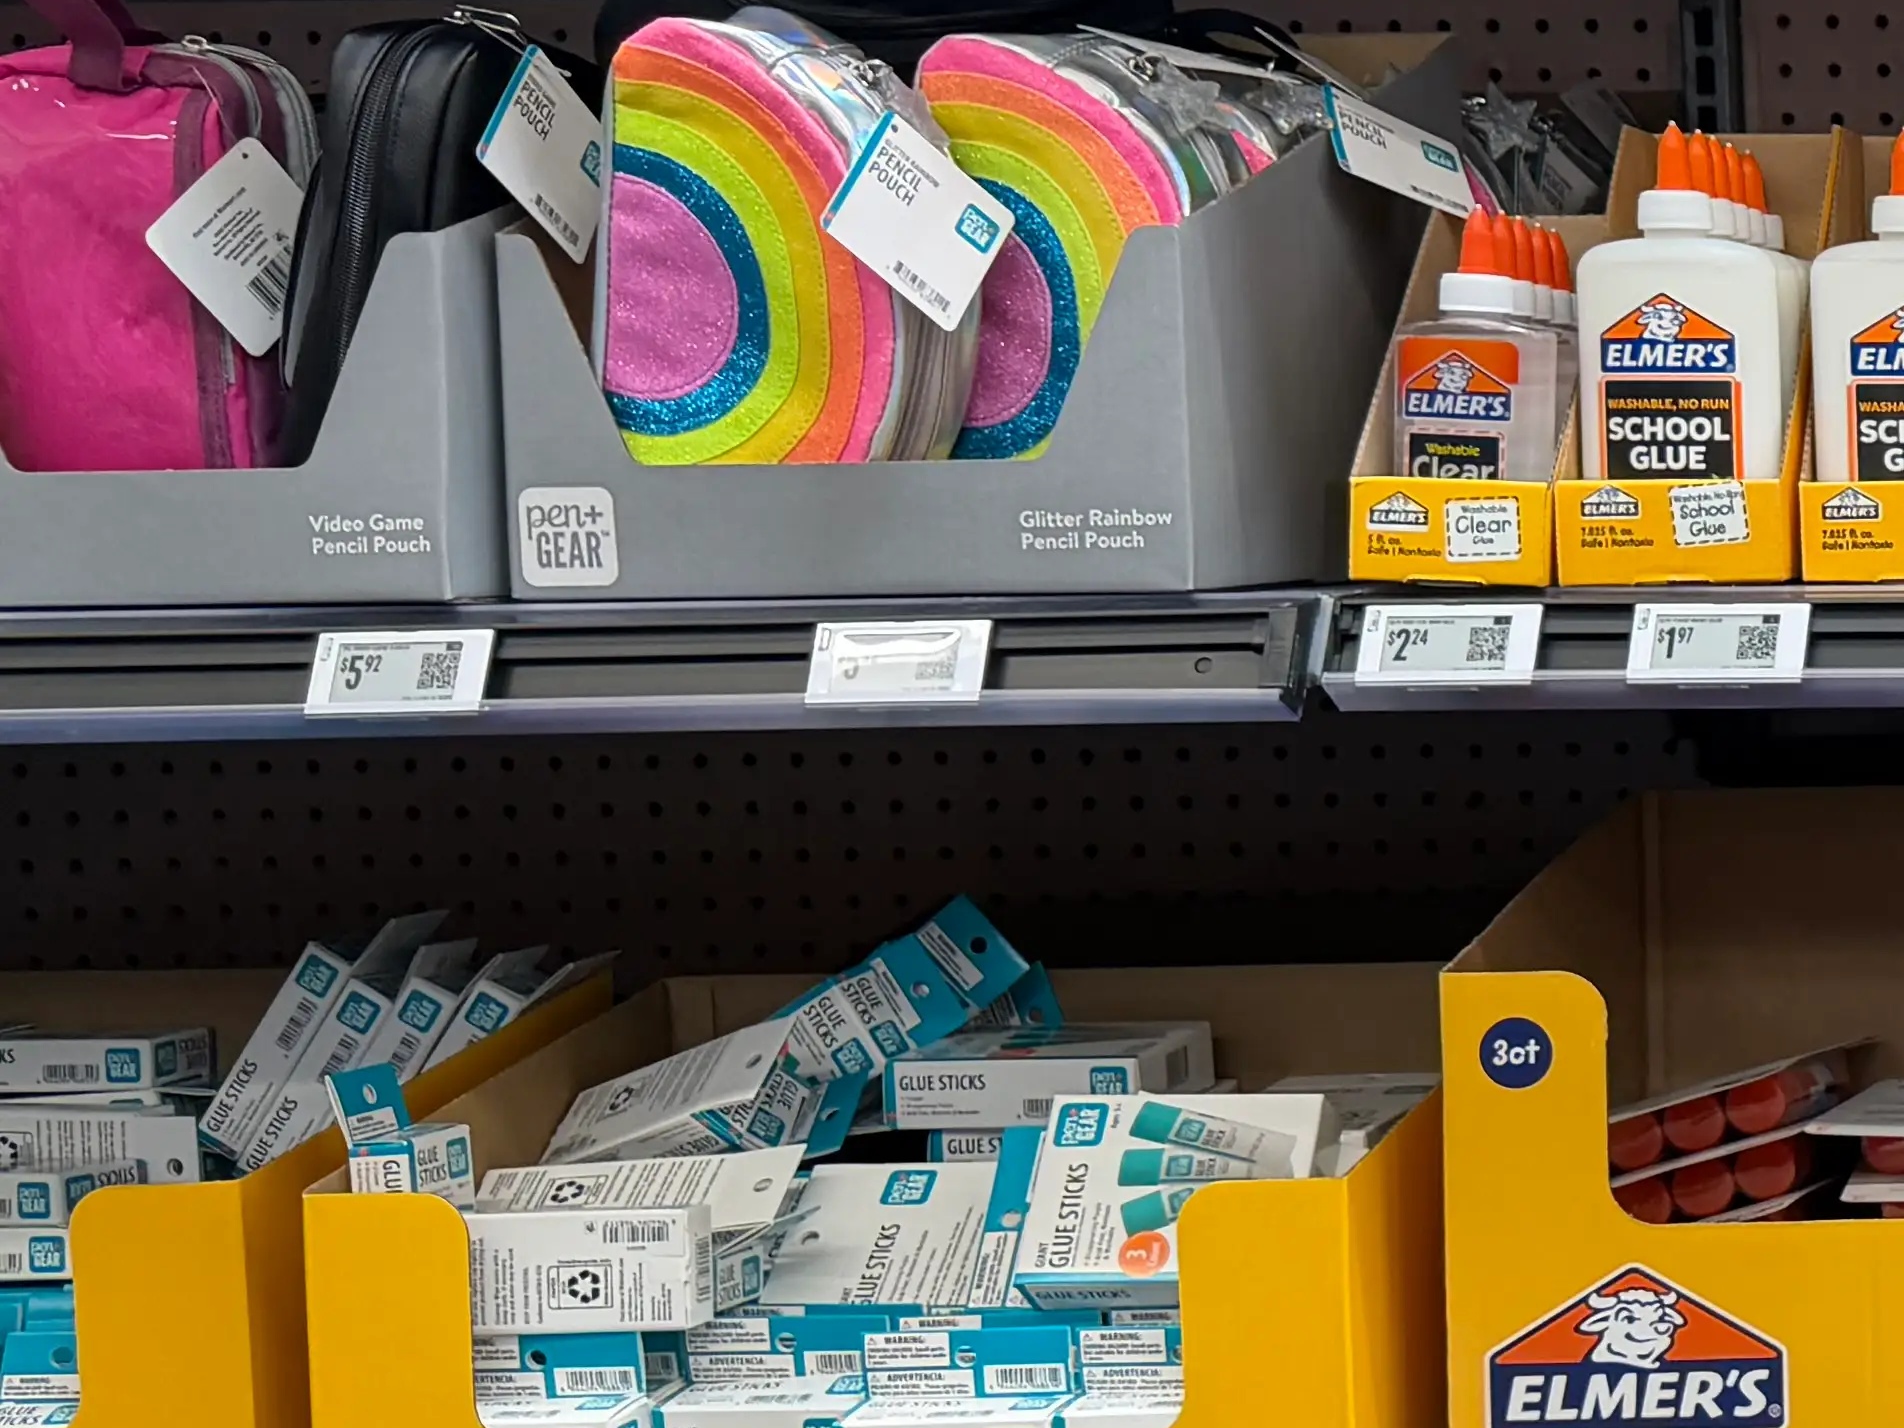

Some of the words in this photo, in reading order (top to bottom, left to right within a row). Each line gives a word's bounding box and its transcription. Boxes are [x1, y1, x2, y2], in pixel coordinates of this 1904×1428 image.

[519, 81, 556, 129] PENCIL
[1609, 417, 1730, 441] SCHOOL
[1630, 445, 1706, 470] GLUE
[309, 514, 365, 534] Video
[369, 514, 424, 532] Game
[312, 536, 368, 554] Pencil
[374, 536, 431, 553] Pouch
[536, 530, 604, 569] GEAR
[1491, 1038, 1540, 1067] 3ct
[898, 1074, 940, 1094] GLUE
[944, 1073, 987, 1093] STICKS
[1505, 1368, 1768, 1423] ELMER'S
